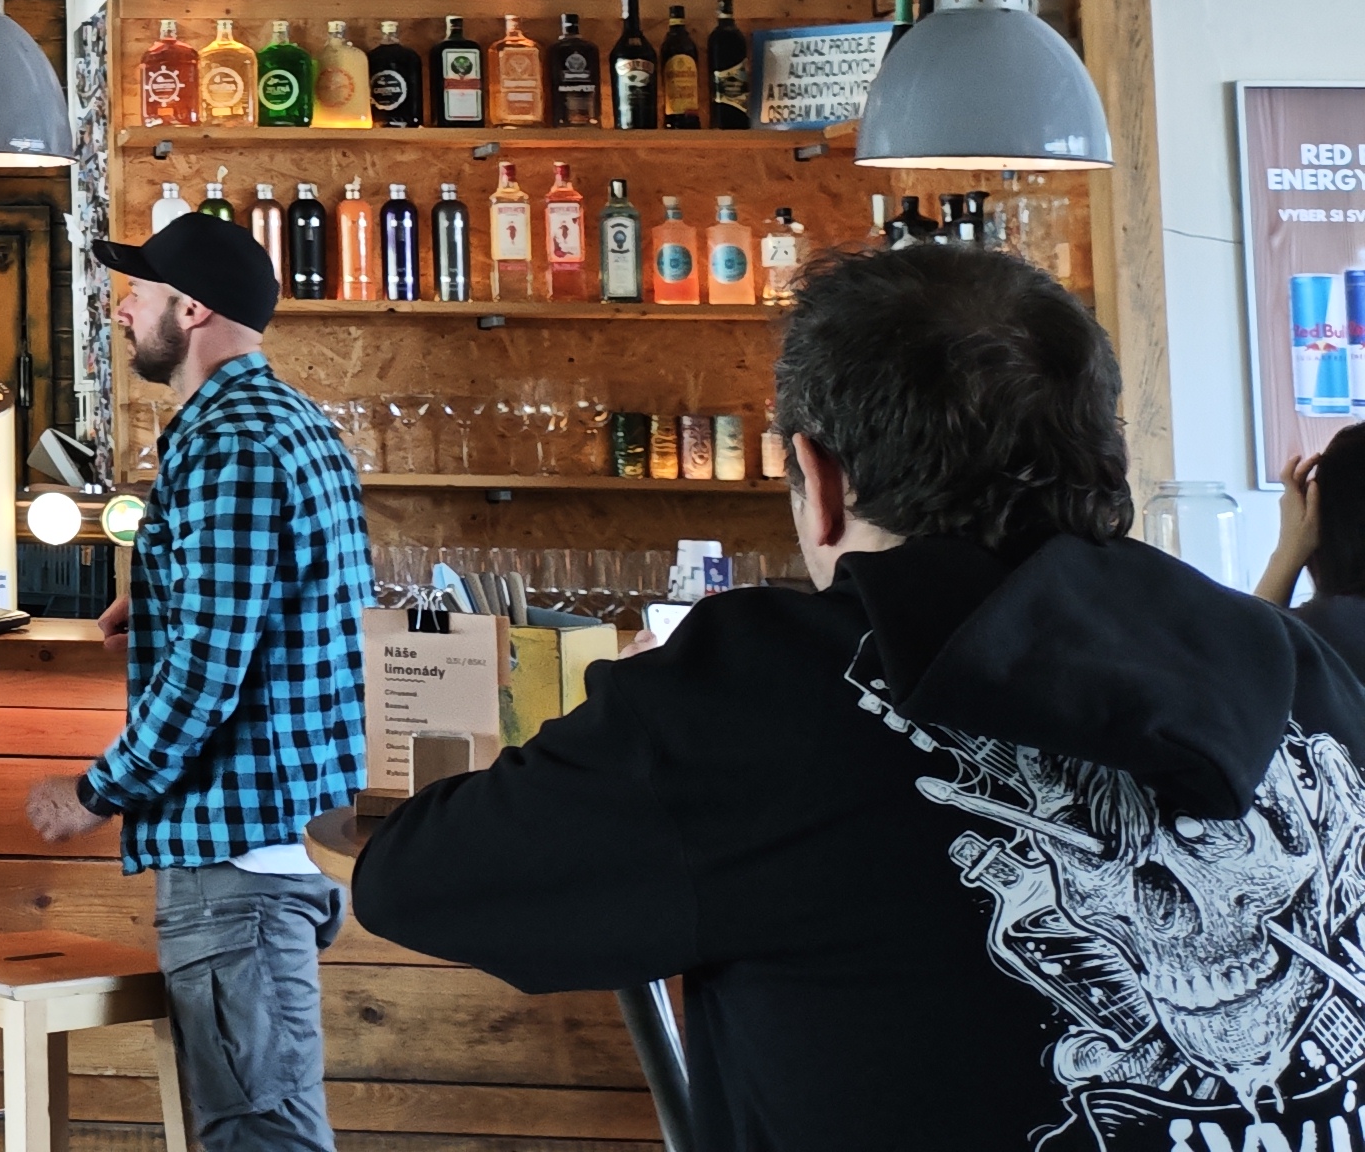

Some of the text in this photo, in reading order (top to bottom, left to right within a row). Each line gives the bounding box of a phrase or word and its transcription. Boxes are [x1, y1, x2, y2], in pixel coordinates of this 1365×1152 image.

[1300, 143, 1352, 165] RED
[1267, 168, 1365, 191] ENERGY
[1278, 208, 1327, 222] VYBER
[384, 663, 446, 680] limonády
